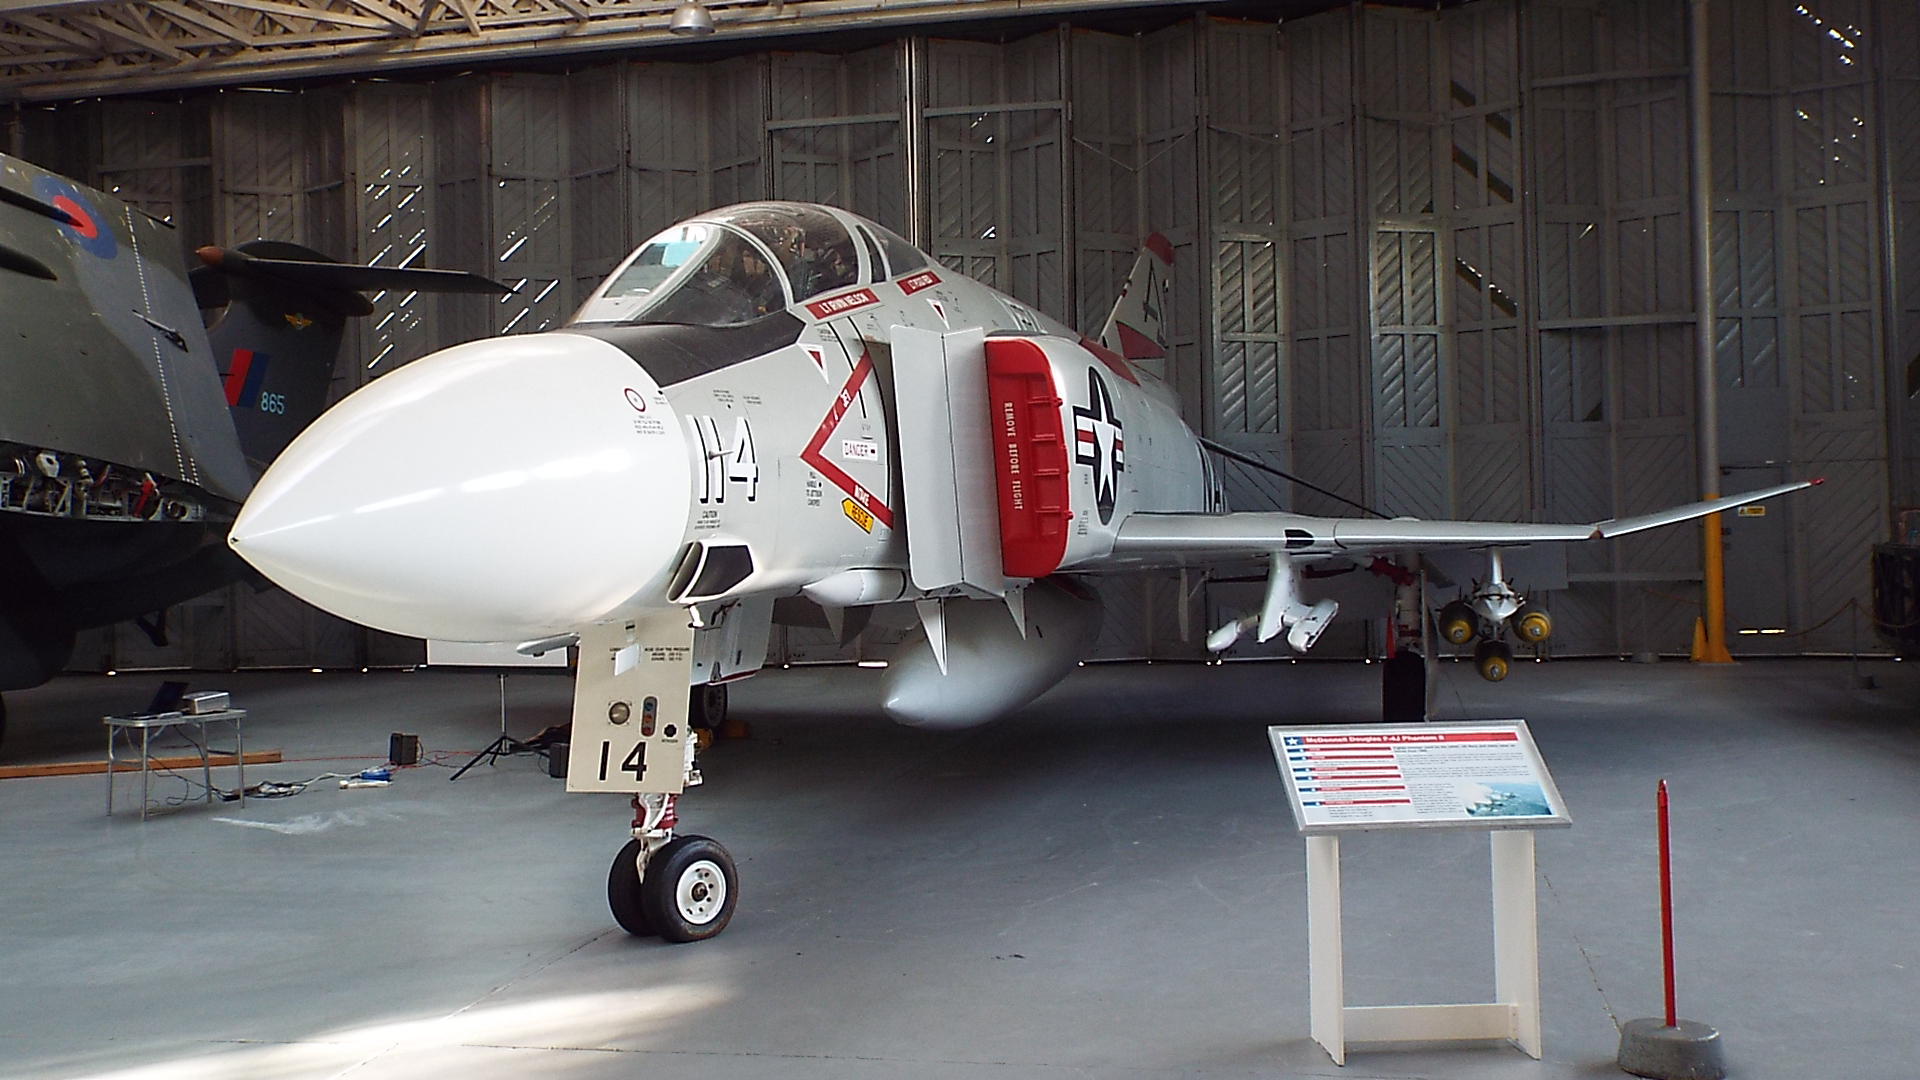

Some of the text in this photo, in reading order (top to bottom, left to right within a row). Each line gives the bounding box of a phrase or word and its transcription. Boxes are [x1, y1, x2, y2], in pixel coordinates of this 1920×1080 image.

[261, 391, 285, 415] 865
[685, 415, 759, 504] 114
[844, 442, 869, 457] DANGER
[1004, 402, 1023, 510] REMOVE BEFORE FLIGHT
[599, 741, 647, 782] 14
